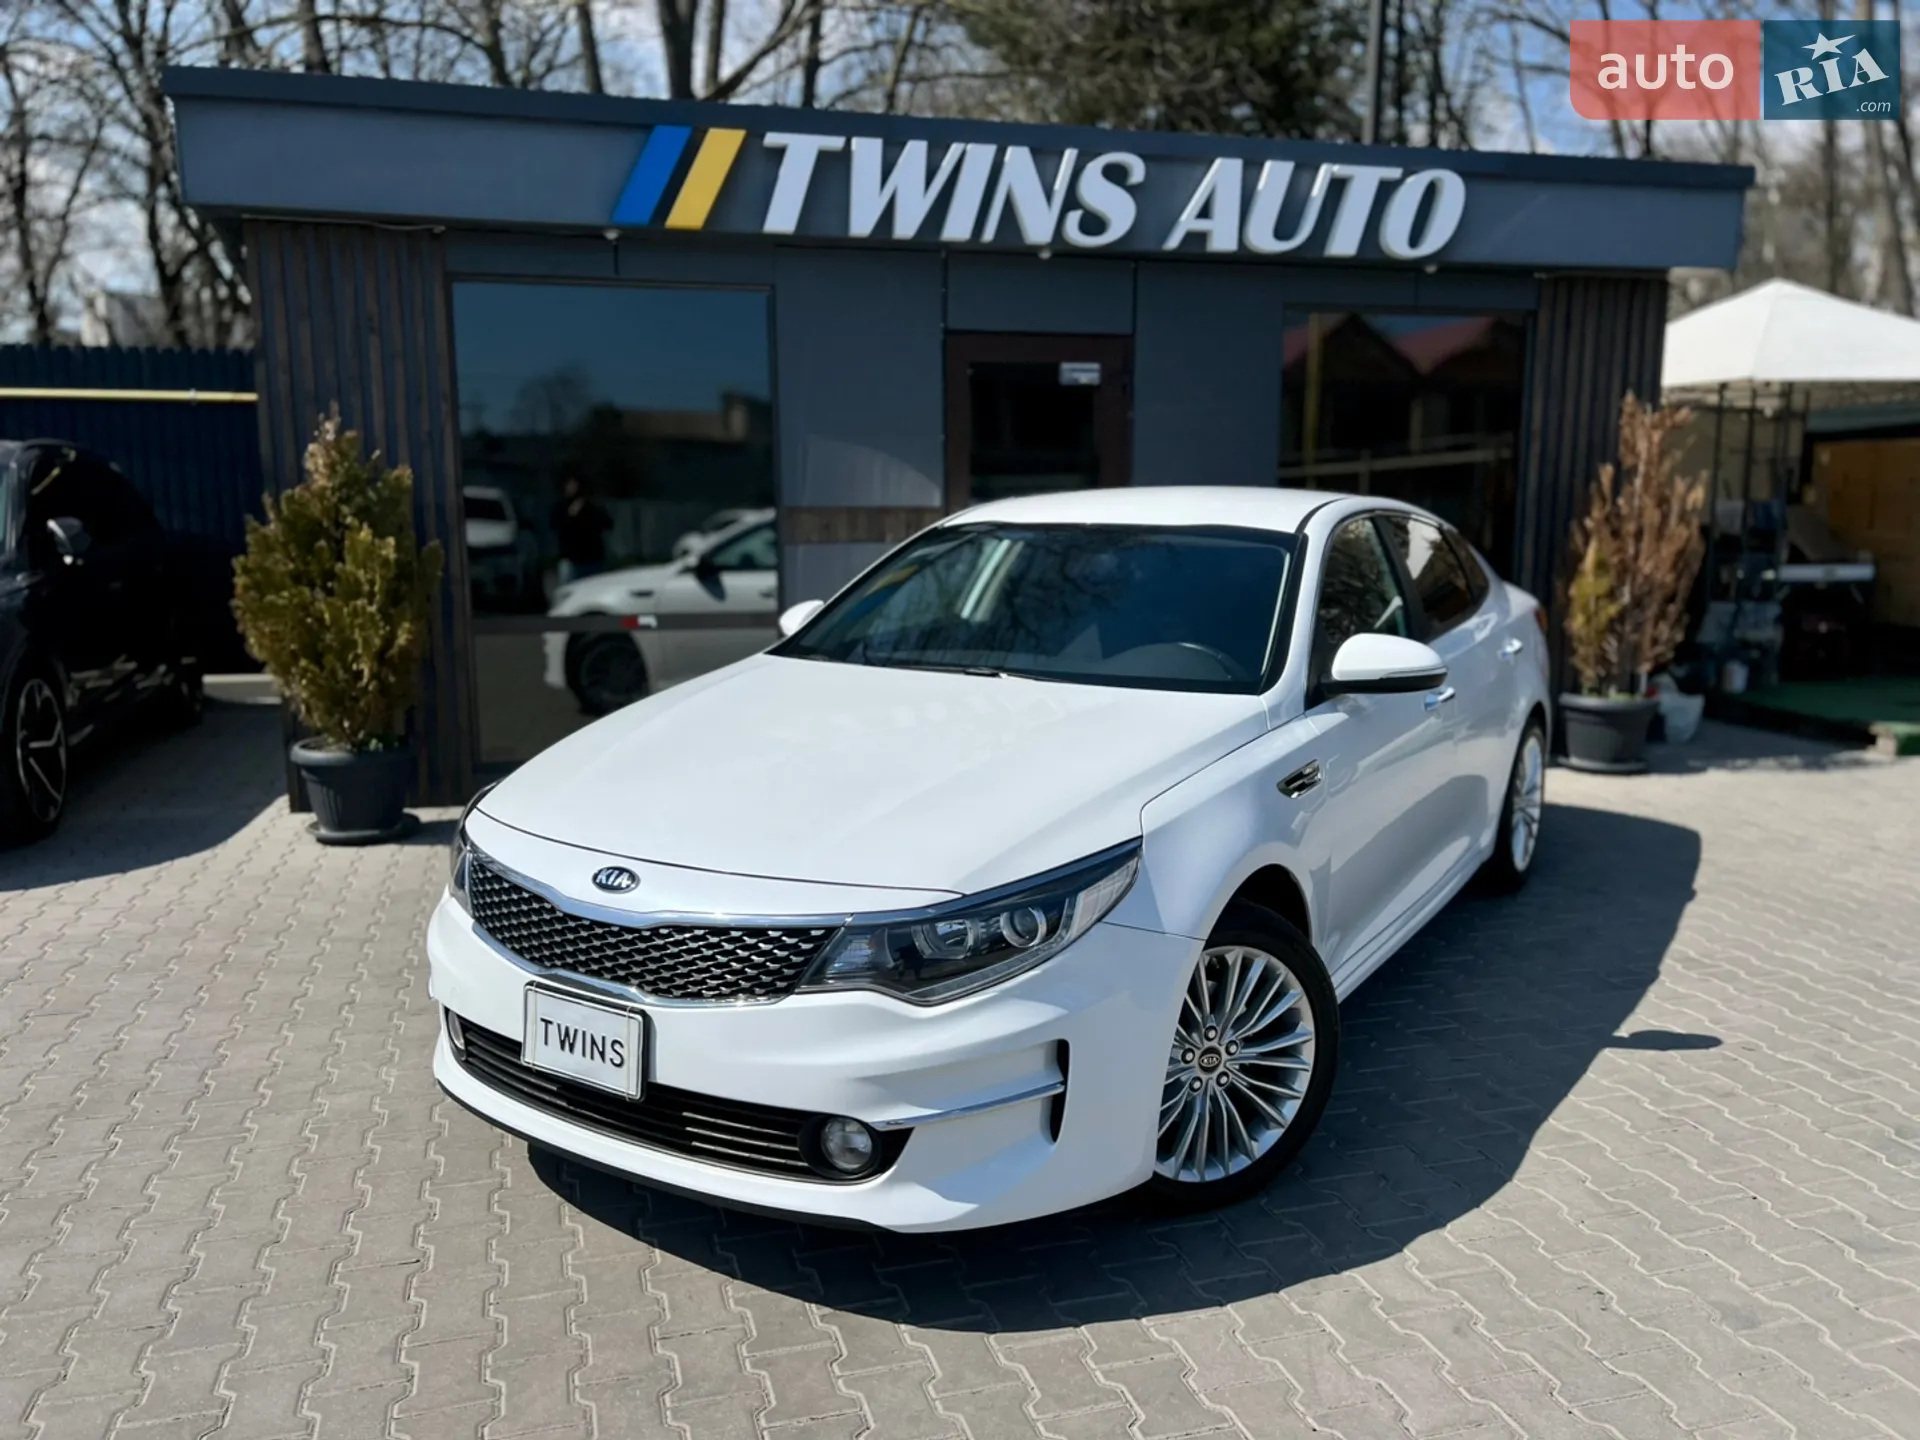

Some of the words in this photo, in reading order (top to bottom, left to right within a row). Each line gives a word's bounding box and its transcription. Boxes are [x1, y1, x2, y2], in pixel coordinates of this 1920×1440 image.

[762, 131, 1146, 248] TWINS
[1163, 157, 1466, 260] AUTO
[595, 868, 632, 888] KIA
[540, 1017, 625, 1068] TWINS
